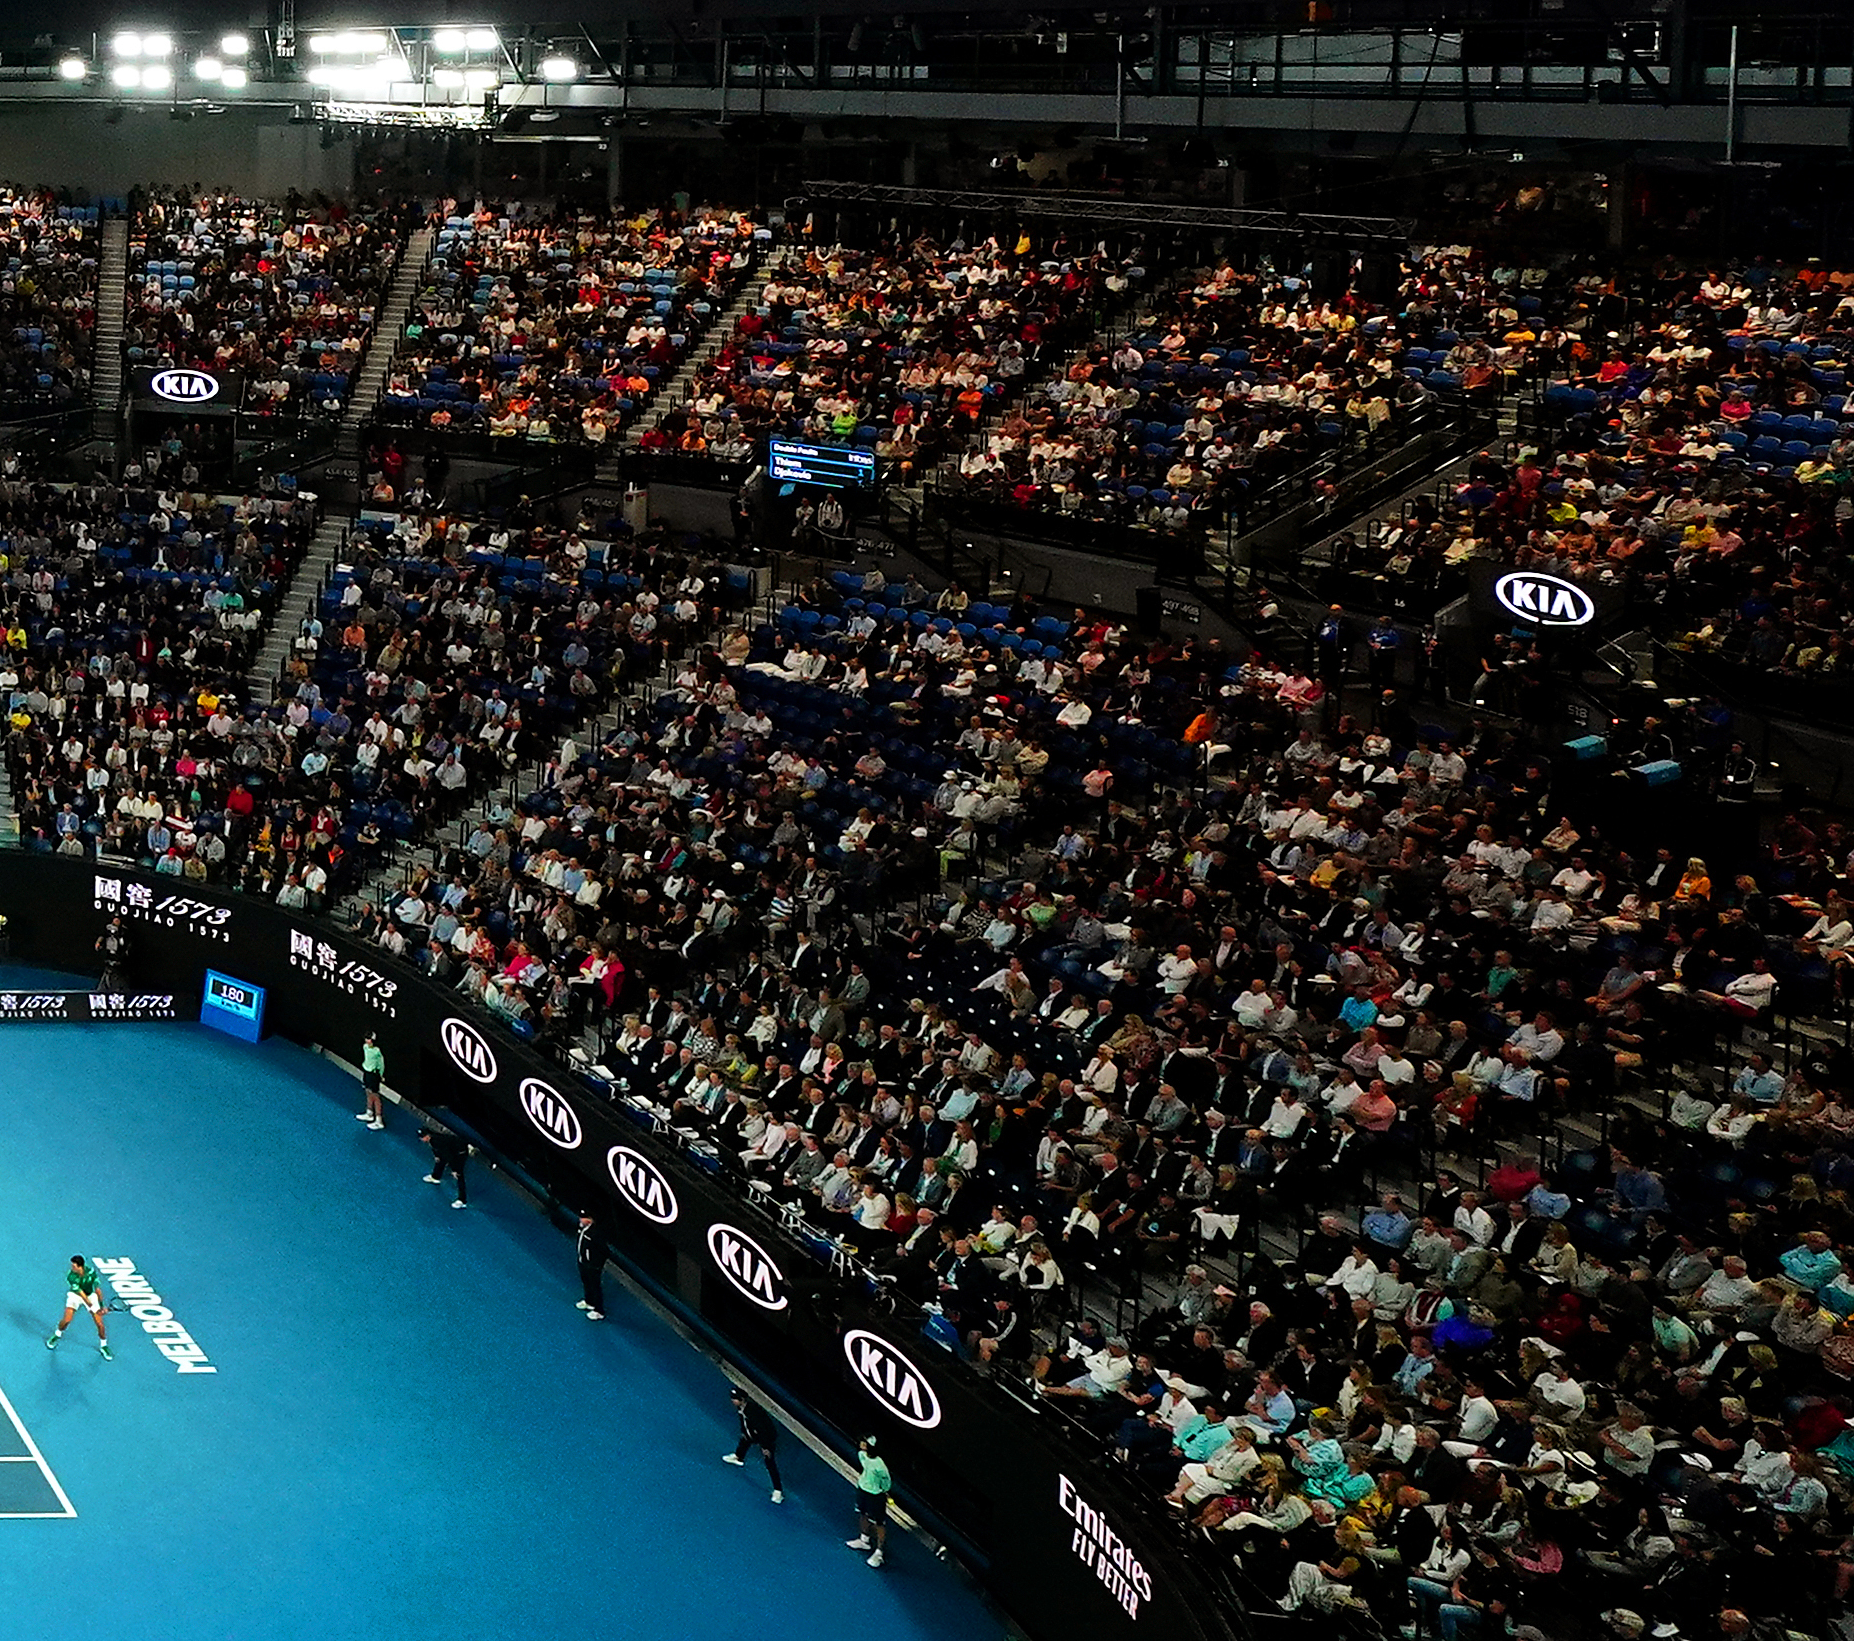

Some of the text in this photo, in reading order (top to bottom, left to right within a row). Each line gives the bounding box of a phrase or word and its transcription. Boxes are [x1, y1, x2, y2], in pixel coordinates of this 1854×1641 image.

[165, 377, 204, 394] KIA
[775, 456, 801, 468] Thiem
[1513, 580, 1577, 619] KIA
[190, 923, 229, 942] 1573
[221, 985, 244, 1004] 180
[451, 1025, 487, 1076] KIA
[530, 1085, 570, 1141] KIA
[620, 1154, 665, 1216] KIA
[722, 1232, 774, 1301] KIA
[91, 1257, 218, 1374] MELBOURNE
[860, 1339, 923, 1419] KIA
[1059, 1473, 1152, 1602] Emirates
[1072, 1527, 1138, 1620] FLY BETTER
